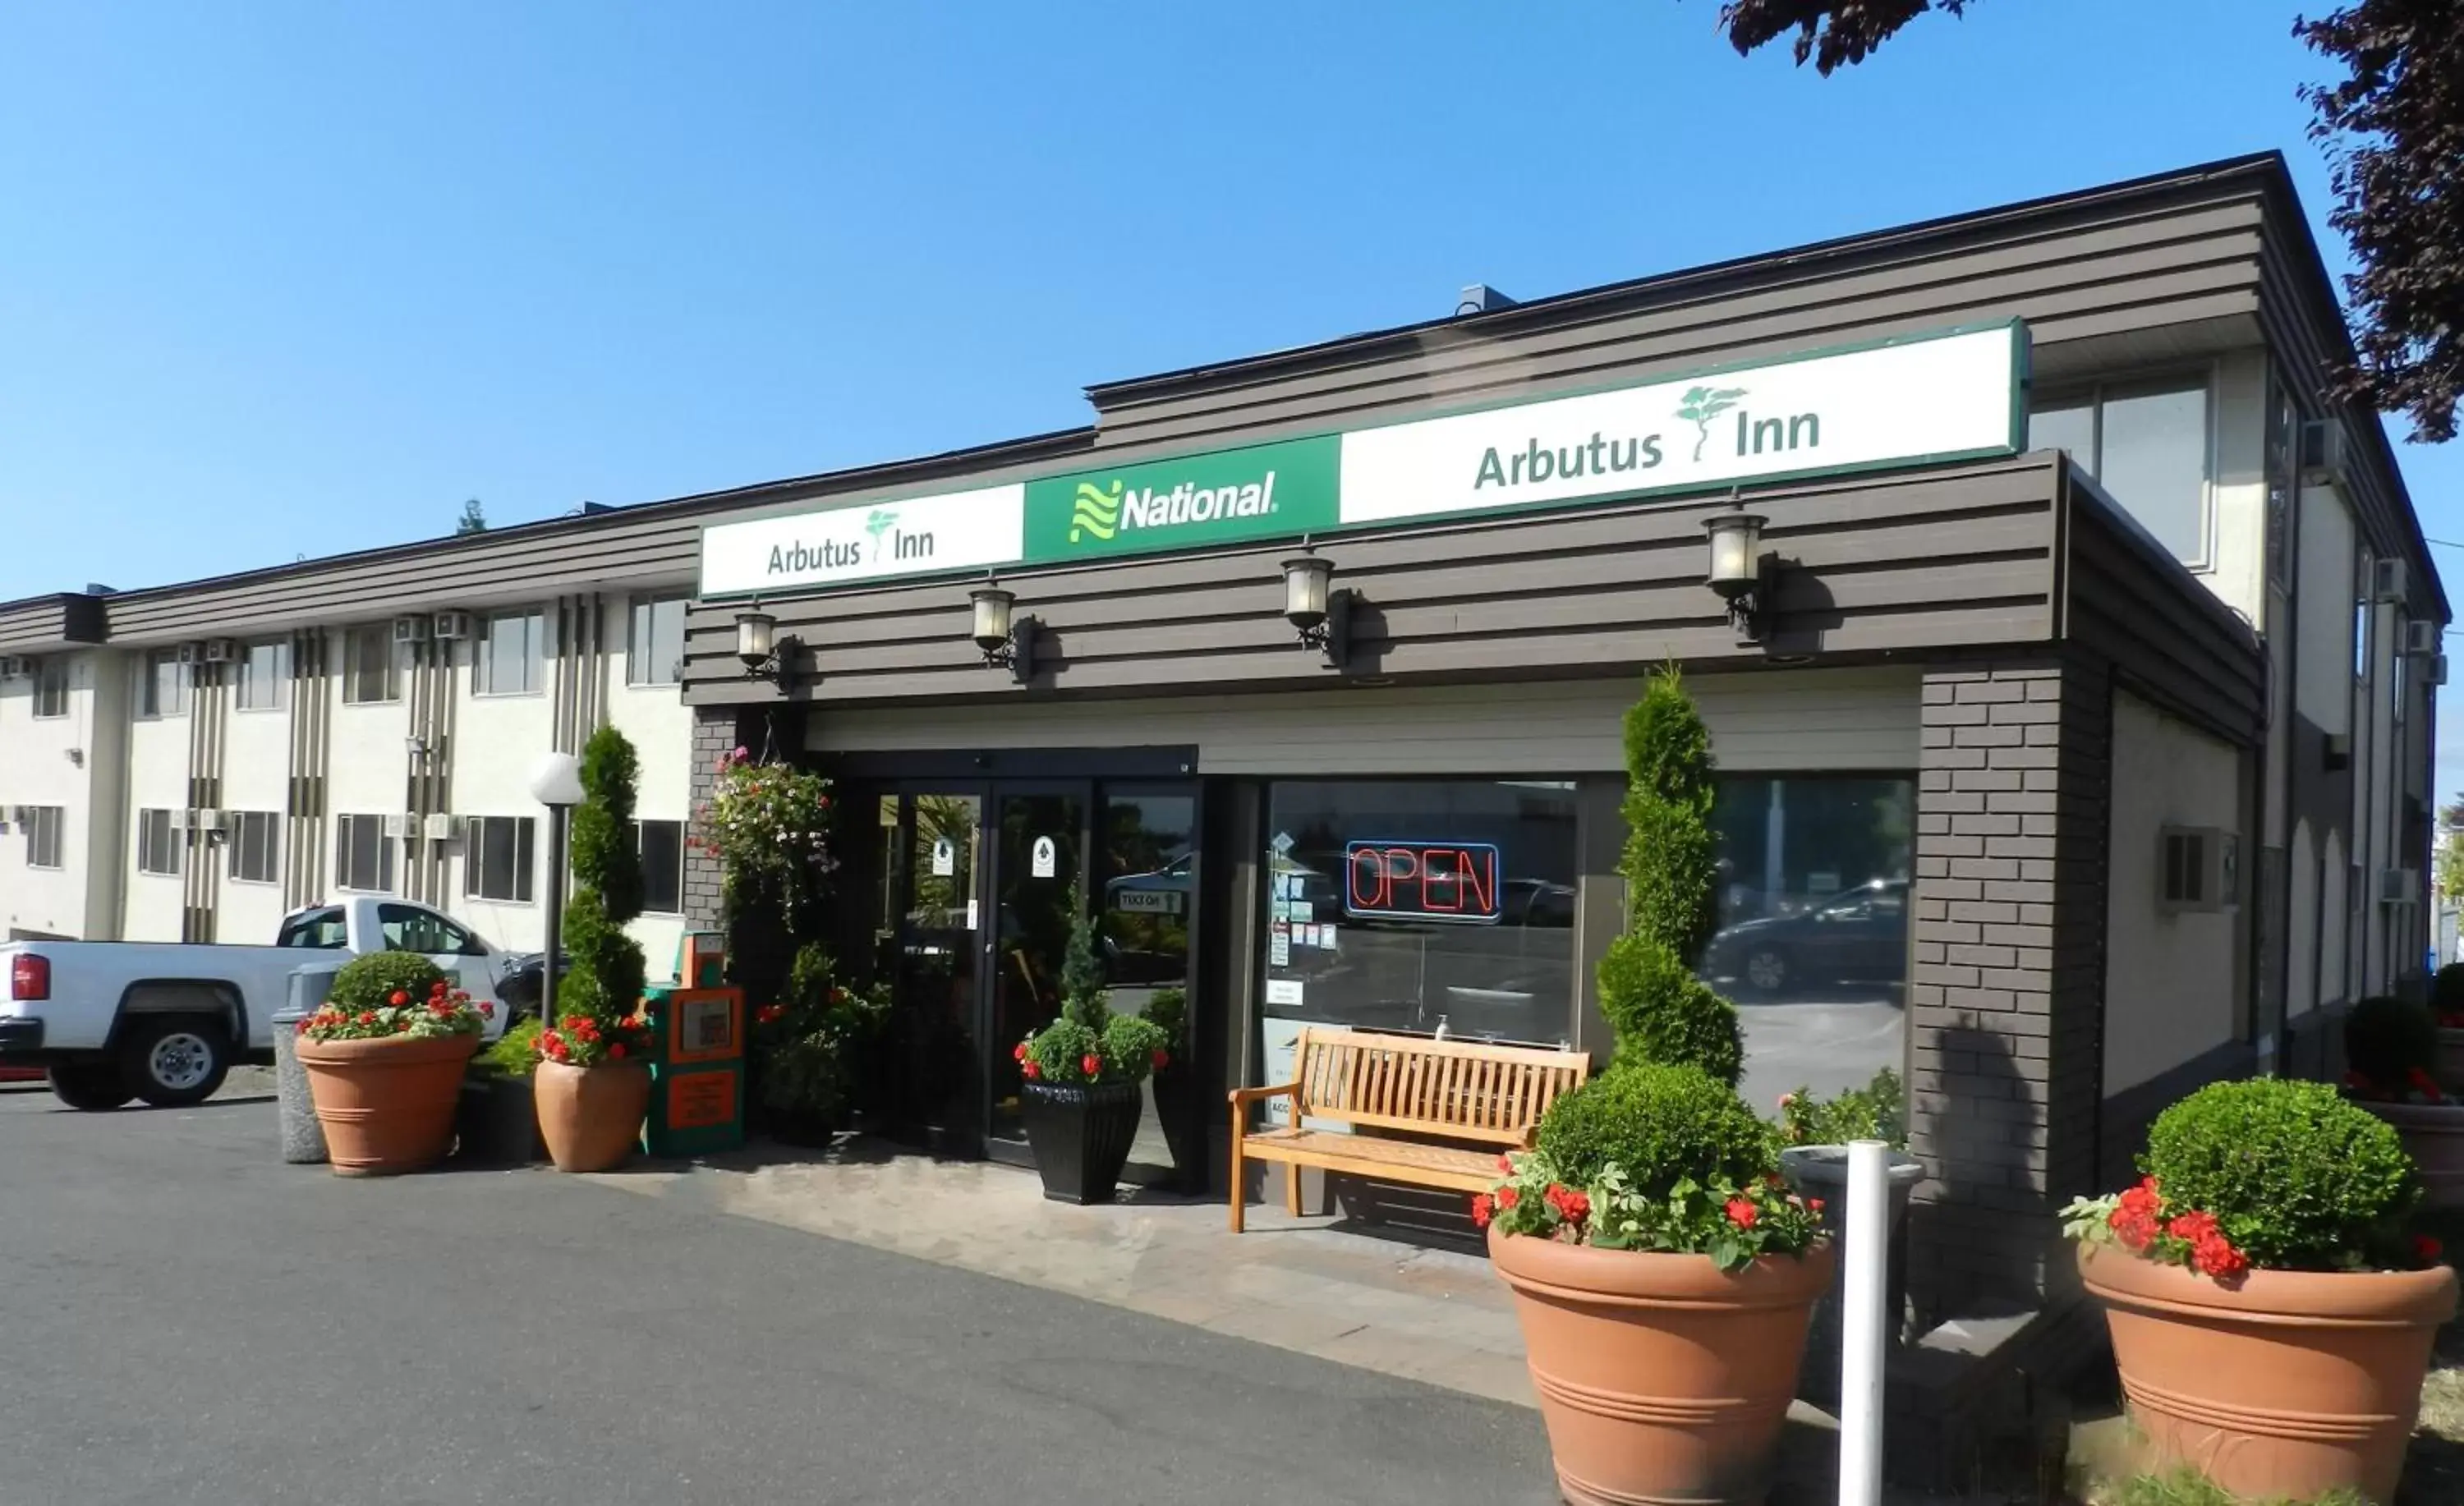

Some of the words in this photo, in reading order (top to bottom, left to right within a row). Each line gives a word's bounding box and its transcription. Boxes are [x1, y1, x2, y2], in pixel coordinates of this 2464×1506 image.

[1473, 432, 1662, 491] Arbutus
[1736, 410, 1820, 457] Inn
[1120, 471, 1276, 531] National
[767, 539, 861, 574] Arbutus
[894, 528, 935, 559] Inn
[1353, 847, 1493, 912] OPEN
